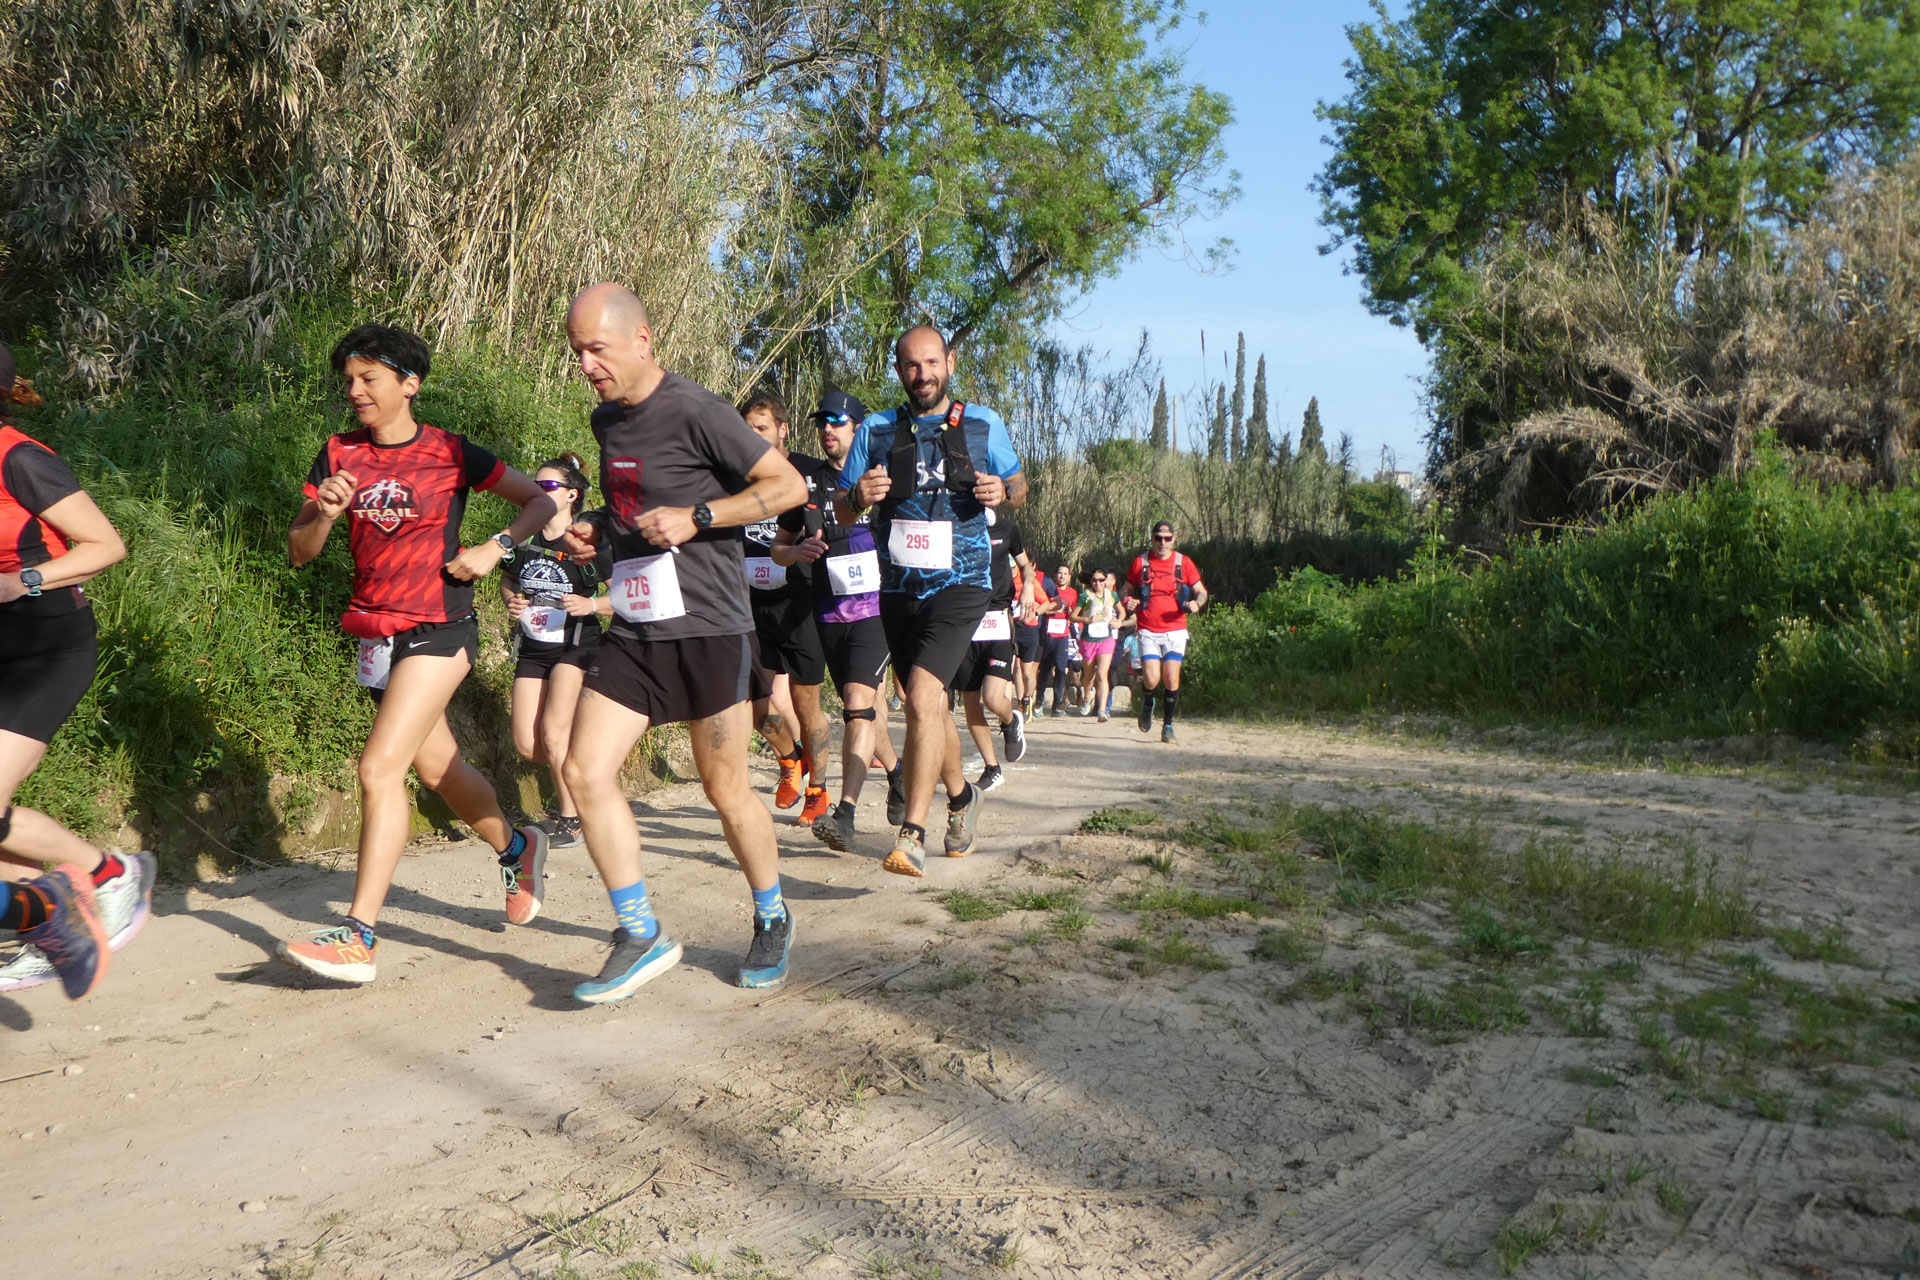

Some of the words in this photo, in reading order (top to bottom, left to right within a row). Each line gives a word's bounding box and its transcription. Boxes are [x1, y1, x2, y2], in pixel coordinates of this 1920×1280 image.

[352, 508, 419, 519] TRAIL
[906, 534, 930, 550] 295
[754, 566, 770, 578] 251
[848, 564, 862, 579] 64
[624, 576, 650, 598] 276
[530, 612, 548, 626] 268
[982, 619, 997, 629] 296
